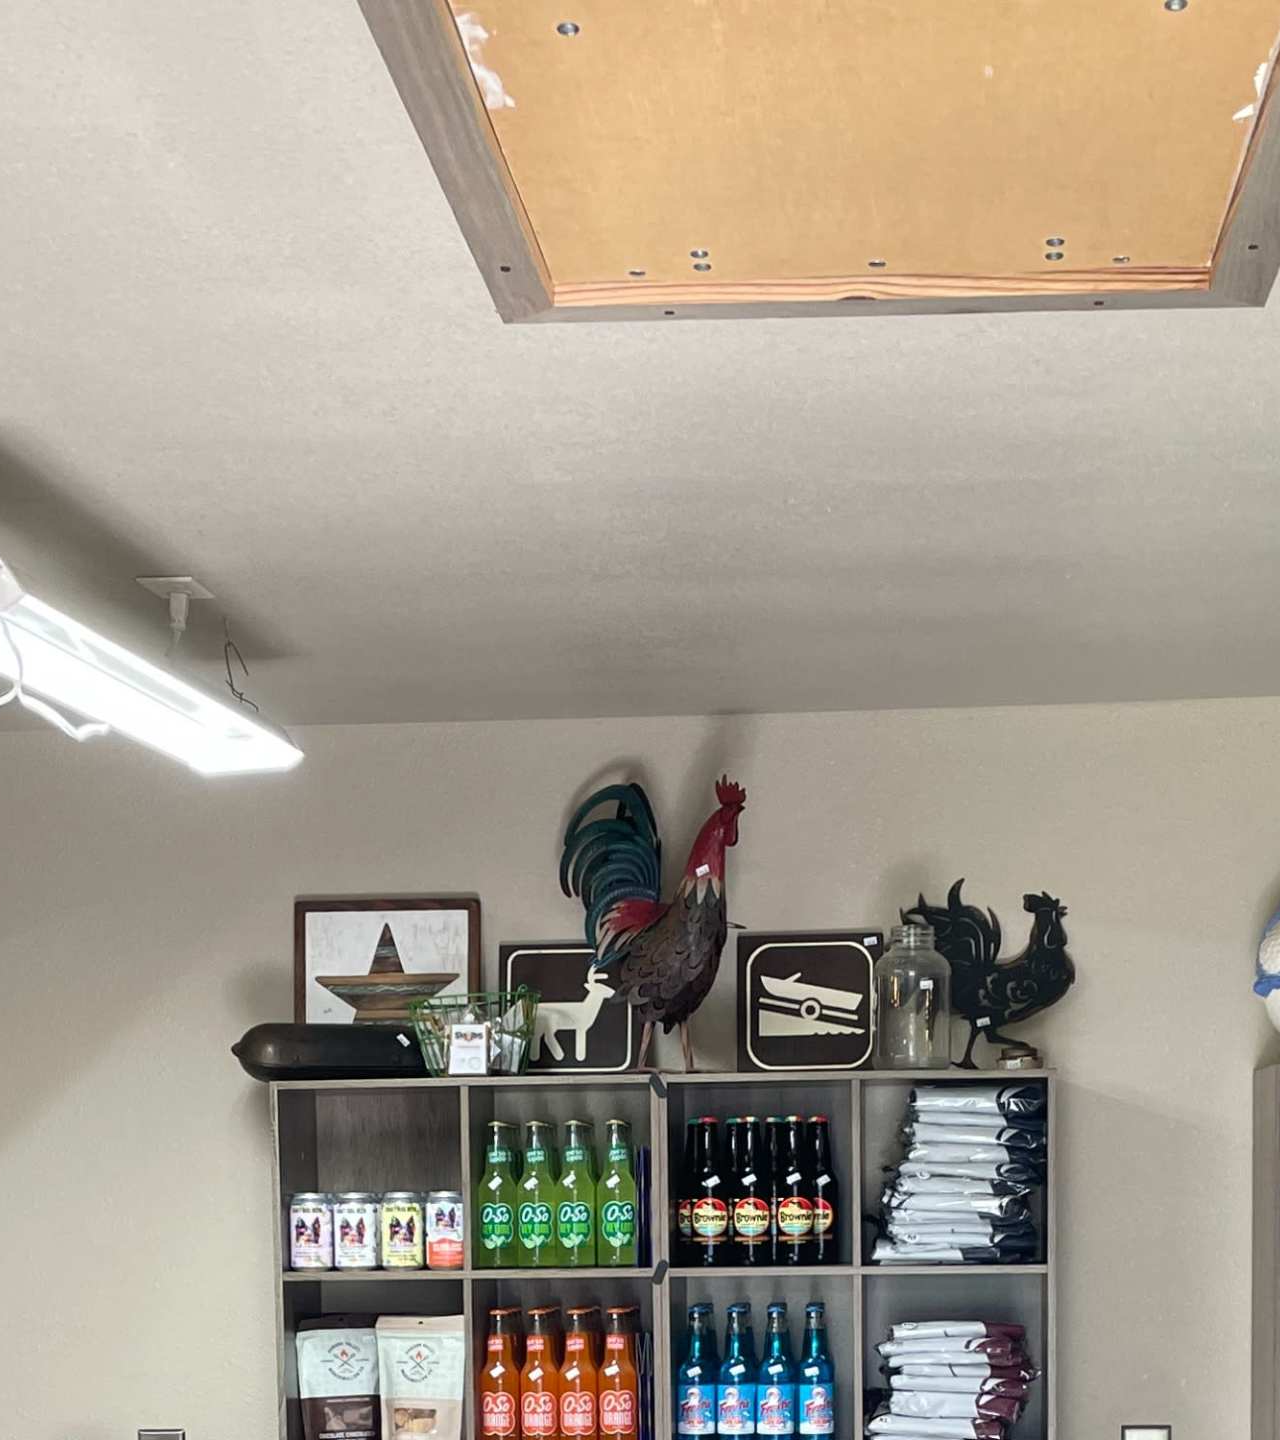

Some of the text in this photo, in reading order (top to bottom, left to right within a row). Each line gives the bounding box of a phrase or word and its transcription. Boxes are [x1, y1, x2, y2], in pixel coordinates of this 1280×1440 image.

[482, 1207, 509, 1223] O-So
[522, 1207, 548, 1222] O-So
[560, 1207, 587, 1222] O-So
[607, 1205, 633, 1221] O-So
[694, 1213, 725, 1224] Brownie
[736, 1212, 768, 1224] Brownie
[780, 1212, 812, 1224] Brownie
[483, 1396, 511, 1412] O-So
[524, 1396, 552, 1412] O-So
[564, 1396, 592, 1412] O-So
[604, 1395, 631, 1411] O-So
